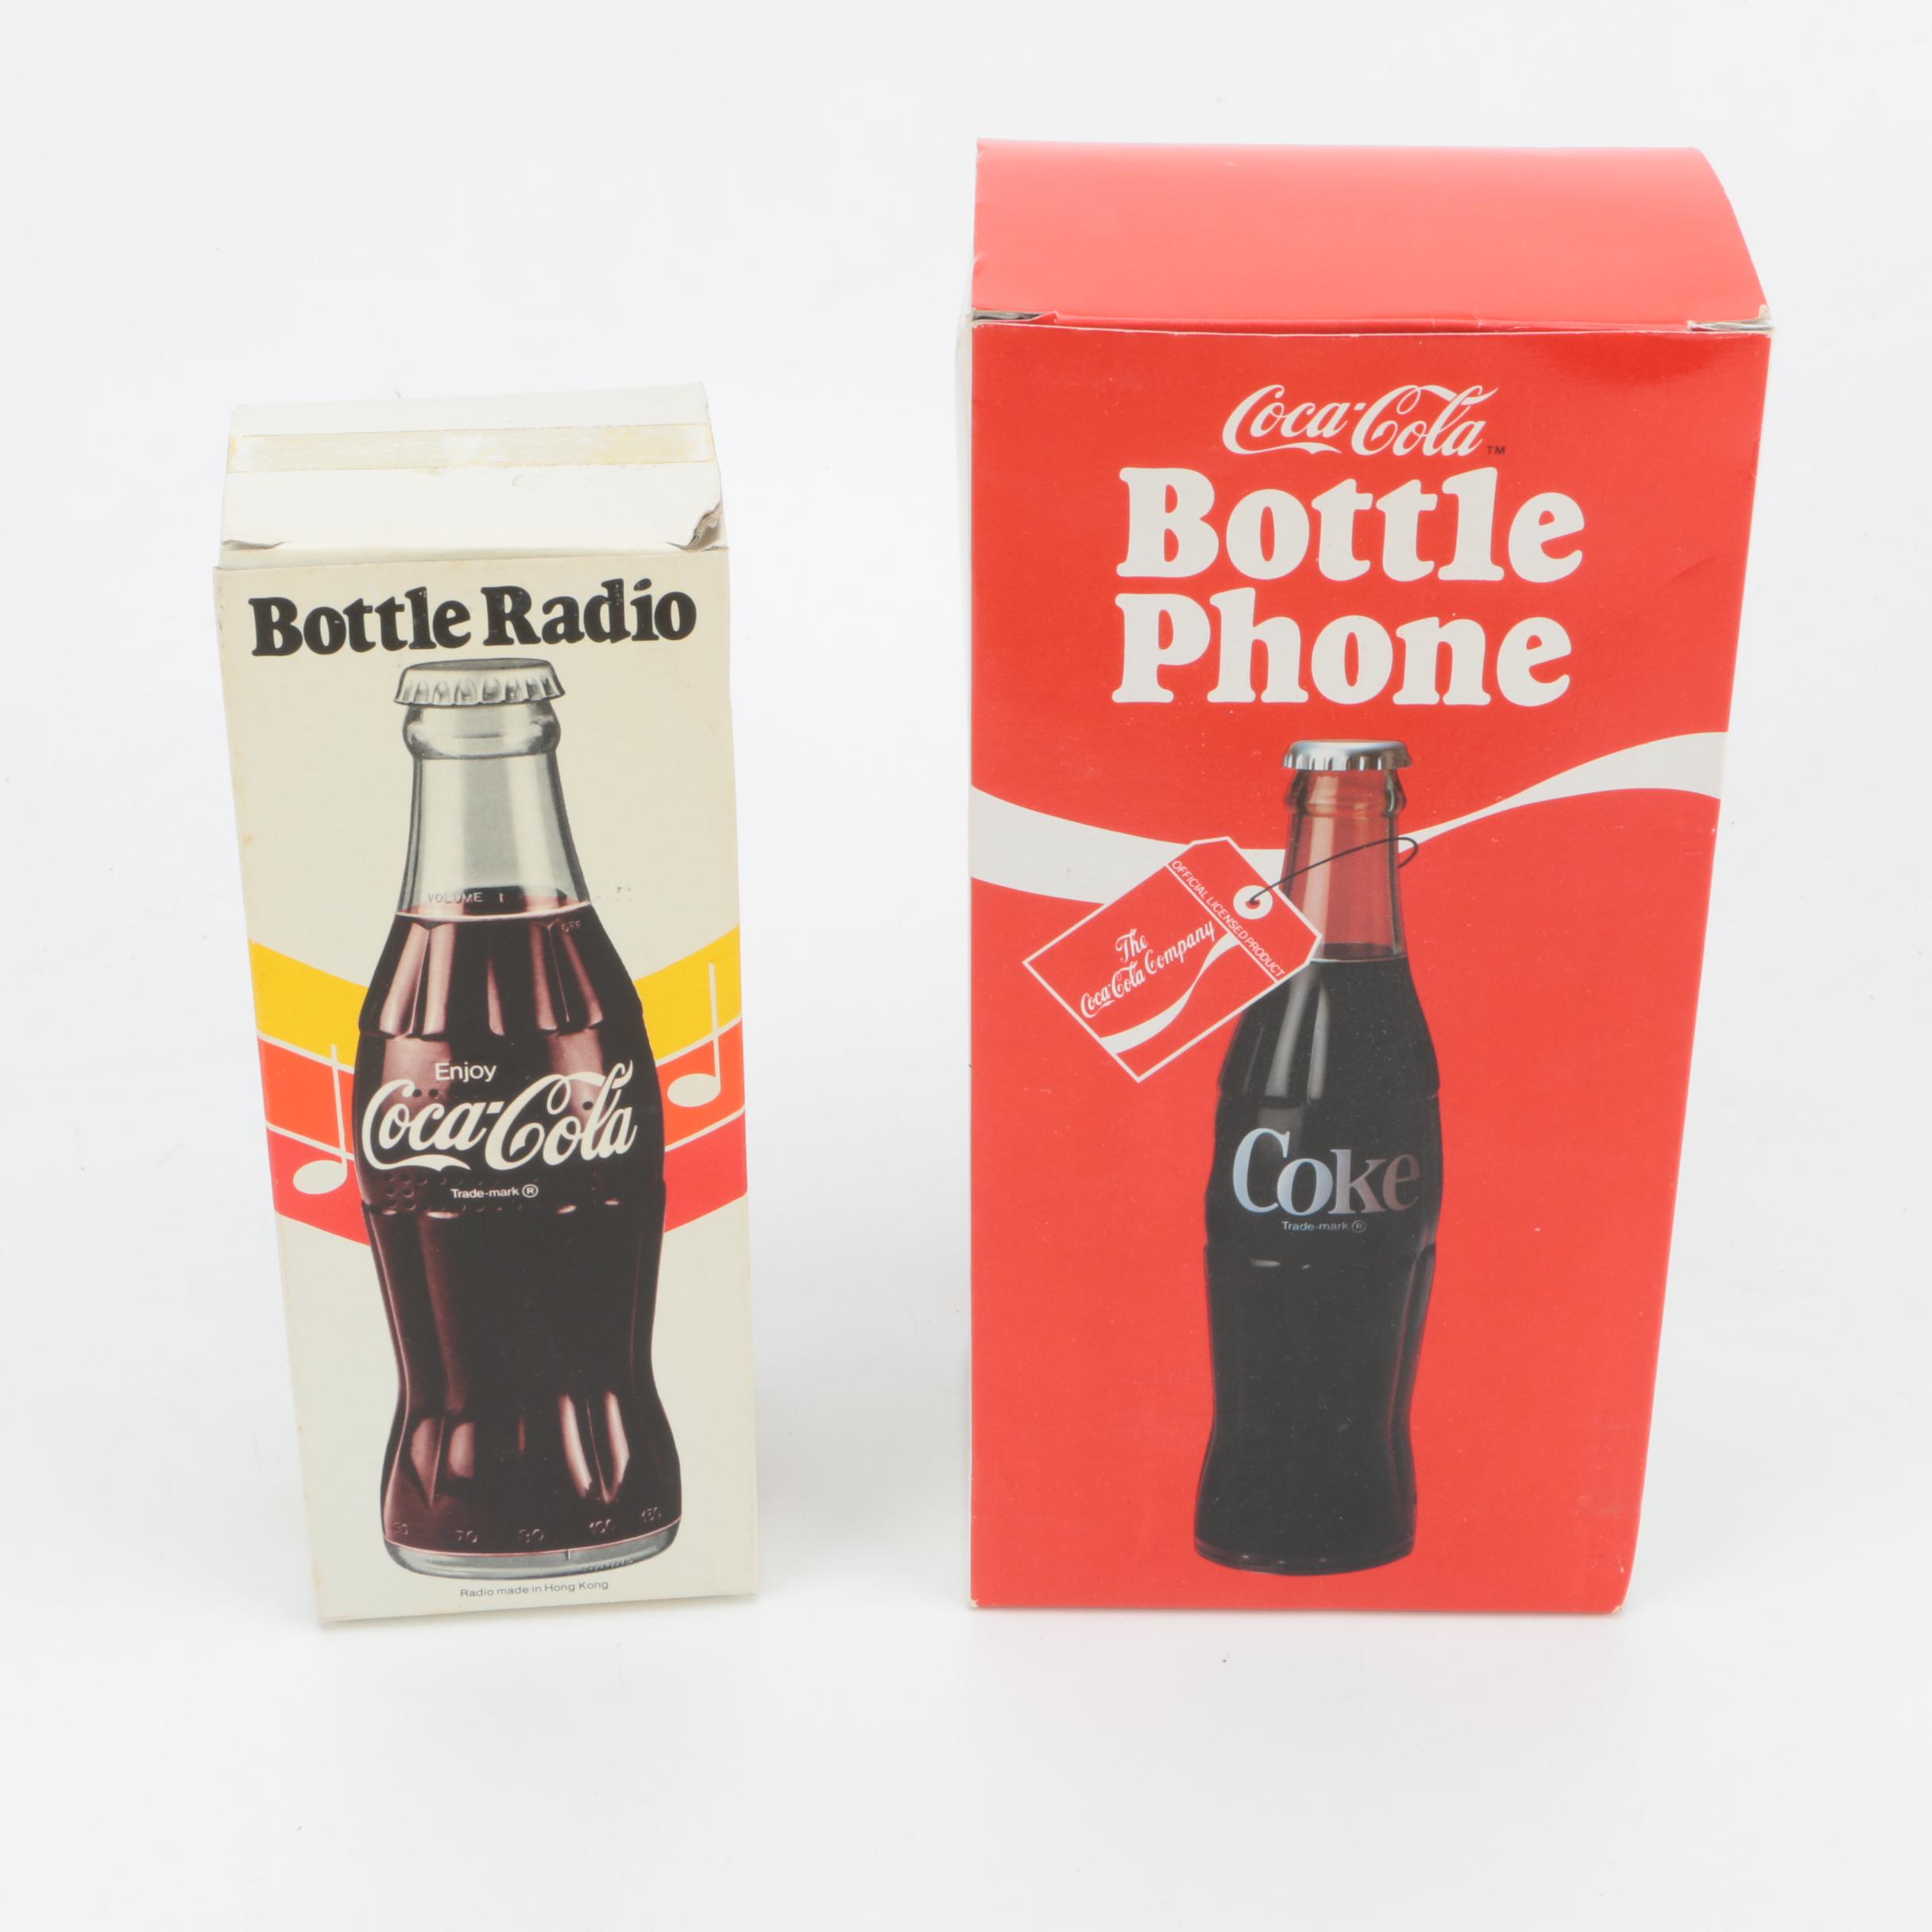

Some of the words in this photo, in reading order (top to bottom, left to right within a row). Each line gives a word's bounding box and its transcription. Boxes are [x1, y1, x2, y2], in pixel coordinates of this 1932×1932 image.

[1222, 384, 1499, 457] Coca-Cola
[1116, 467, 1585, 583] Bottle
[248, 586, 472, 657] Bottle
[481, 578, 697, 647] Radio
[1112, 587, 1571, 707] Phone
[427, 892, 483, 903] VOLUME
[1172, 860, 1209, 899] OFFICIAL
[1206, 896, 1249, 939] LICENSED
[1245, 937, 1286, 977] PRODUCT
[1080, 960, 1146, 1018] Coca-Cola
[1144, 921, 1215, 976] Company
[1115, 928, 1148, 964] The
[435, 1061, 497, 1084] Enjoy
[361, 1059, 638, 1172] Coca-Cola
[450, 1186, 520, 1199] Trade-mark
[1232, 1127, 1421, 1216] Coke
[1281, 1221, 1349, 1231] Trade-mark
[460, 1588, 494, 1598] Radio
[497, 1586, 529, 1596] made
[531, 1584, 543, 1594] in
[544, 1583, 575, 1594] Hong
[578, 1581, 609, 1590] Kong
